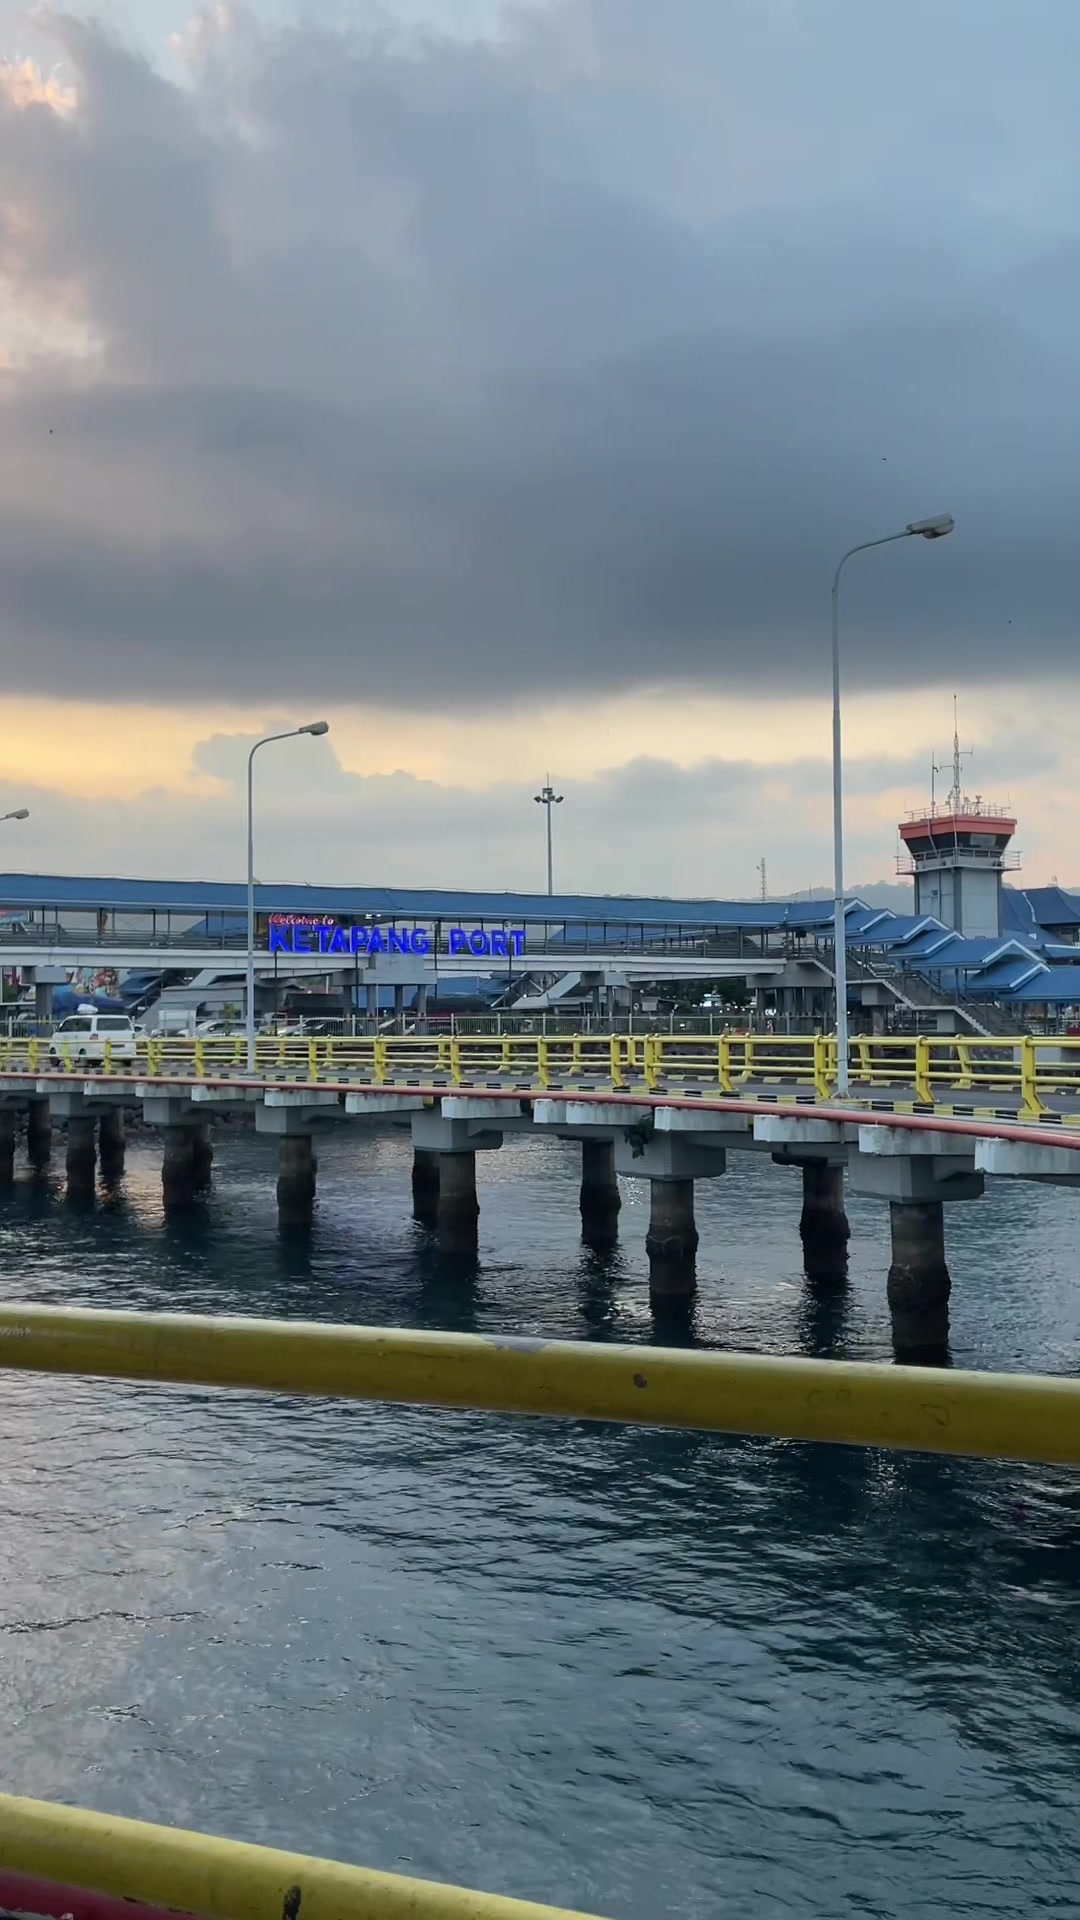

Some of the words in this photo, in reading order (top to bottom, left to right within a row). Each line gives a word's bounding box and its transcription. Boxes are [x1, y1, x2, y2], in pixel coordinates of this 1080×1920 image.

[269, 913, 319, 925] Welcome
[322, 914, 334, 925] to
[268, 925, 429, 955] KETAPANG
[448, 928, 527, 957] PORT
